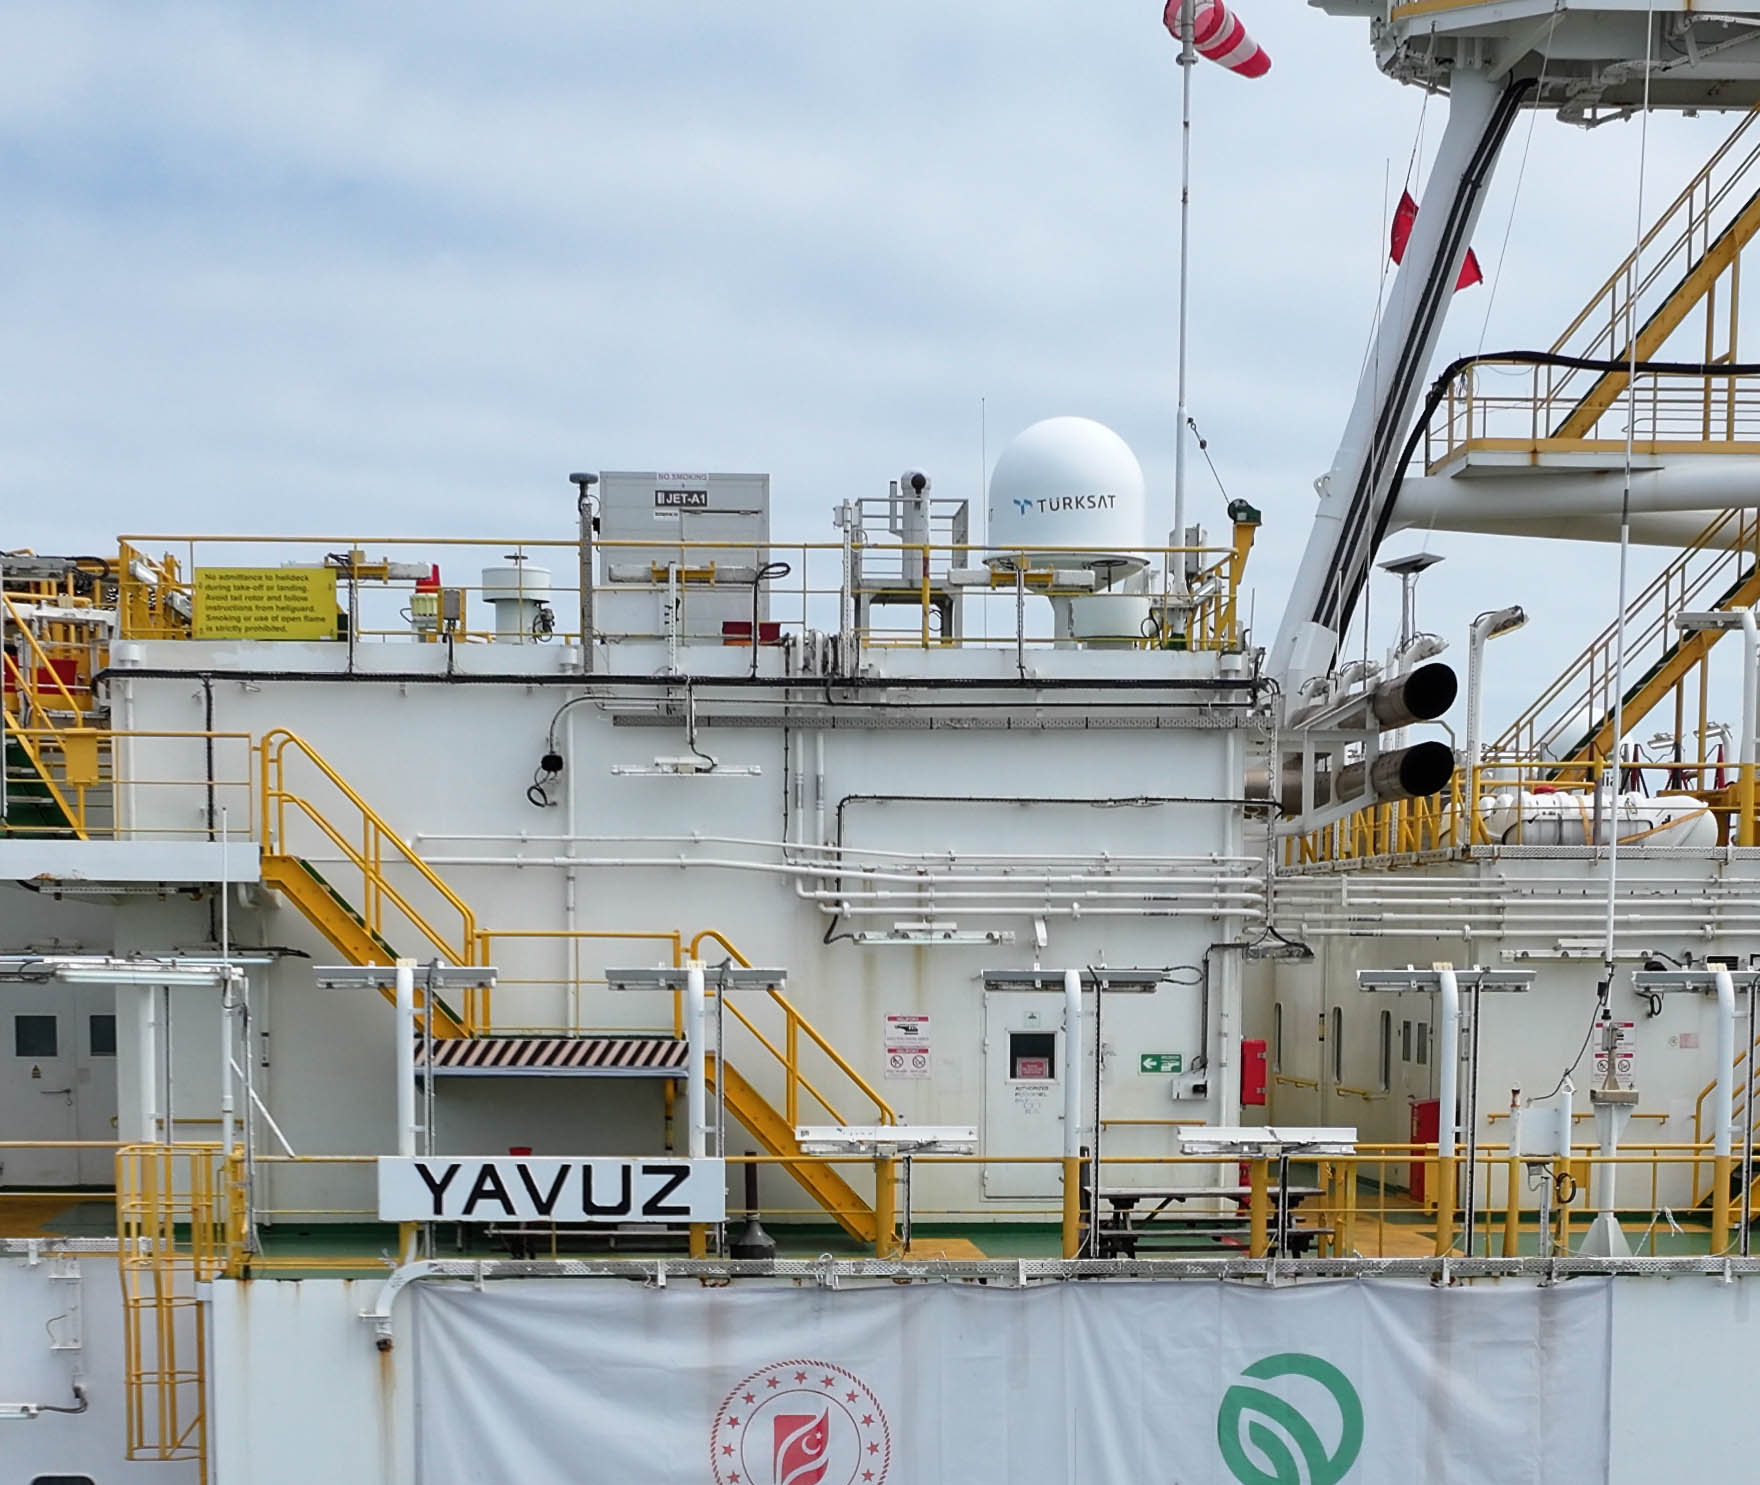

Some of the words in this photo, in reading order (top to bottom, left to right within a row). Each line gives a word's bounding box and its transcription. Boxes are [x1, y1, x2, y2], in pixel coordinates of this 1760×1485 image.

[666, 493, 706, 504] JET-A1
[205, 584, 231, 592] during
[206, 615, 241, 623] Smoking
[215, 625, 242, 633] strictly
[244, 625, 288, 633] prohibited.
[415, 1164, 690, 1216] YAVUZ
